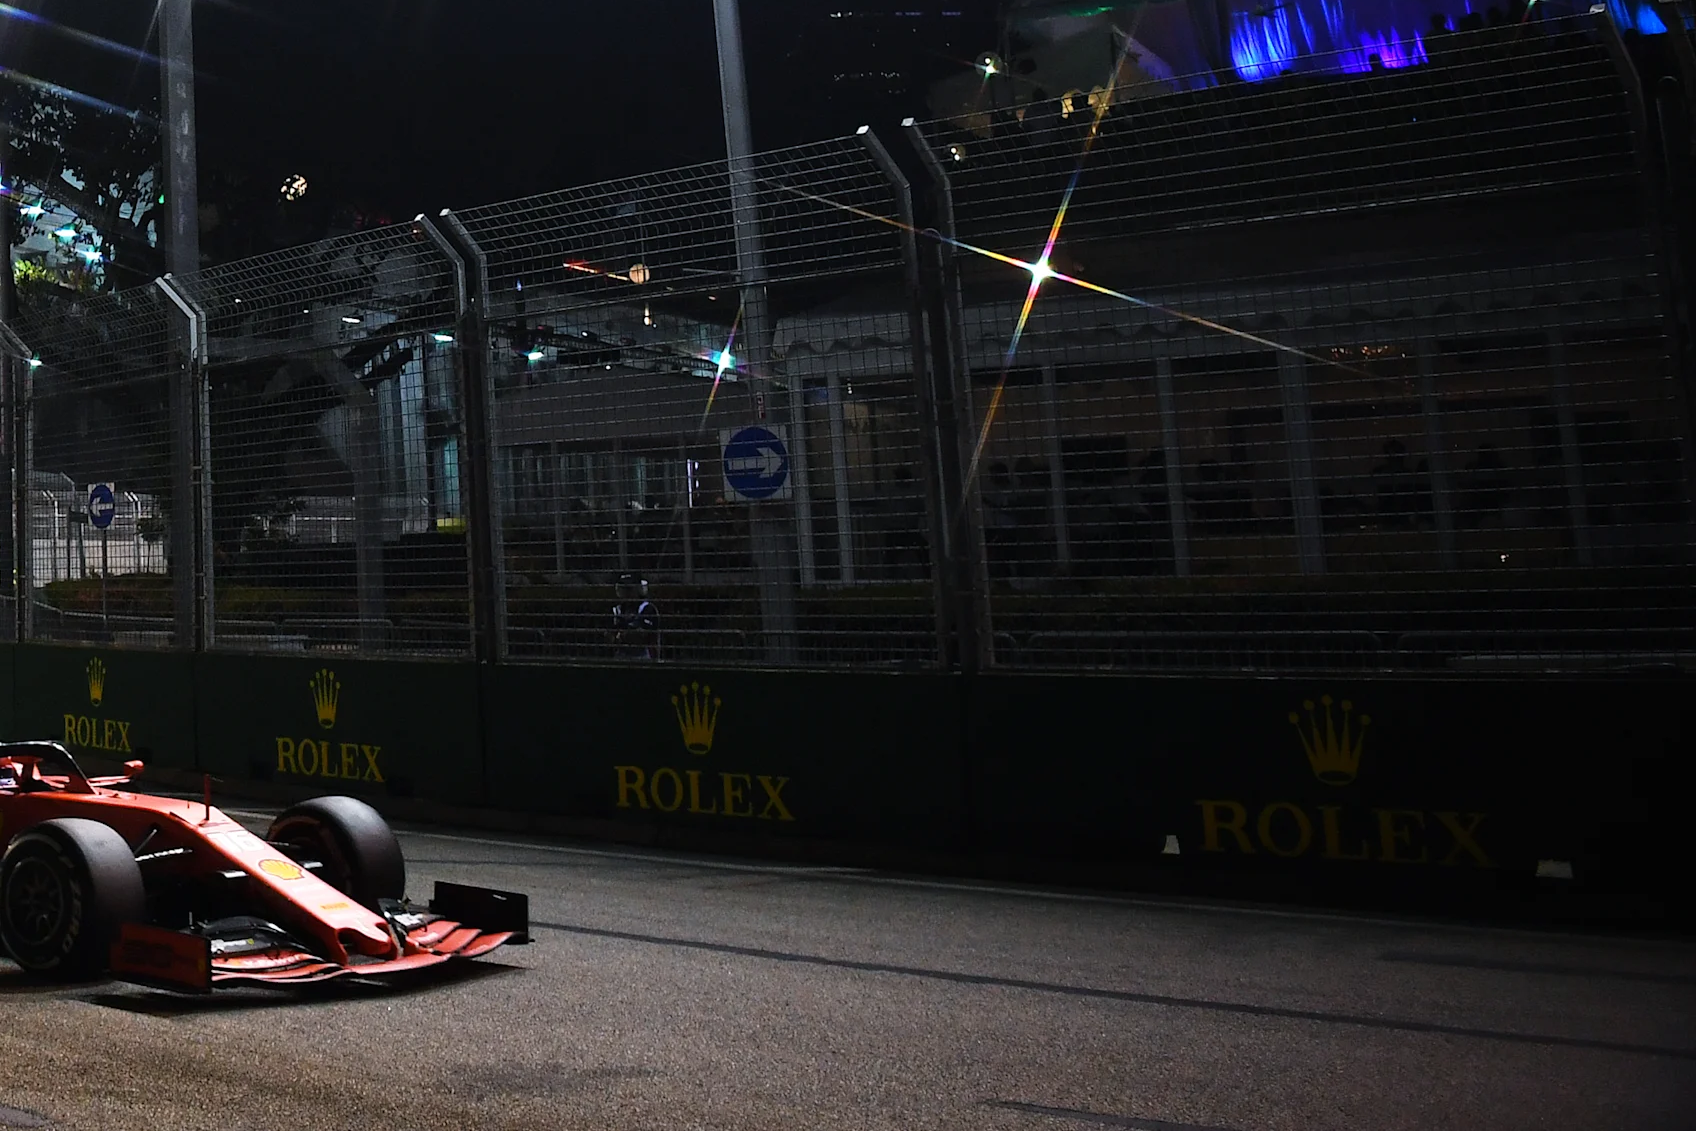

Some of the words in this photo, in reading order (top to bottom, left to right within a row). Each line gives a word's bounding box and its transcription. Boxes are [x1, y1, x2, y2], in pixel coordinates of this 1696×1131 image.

[63, 713, 132, 754] ROLEX
[275, 735, 387, 783] ROLEX
[614, 765, 797, 821] ROLEX
[206, 829, 265, 853] 16
[1194, 798, 1501, 869] ROLEX
